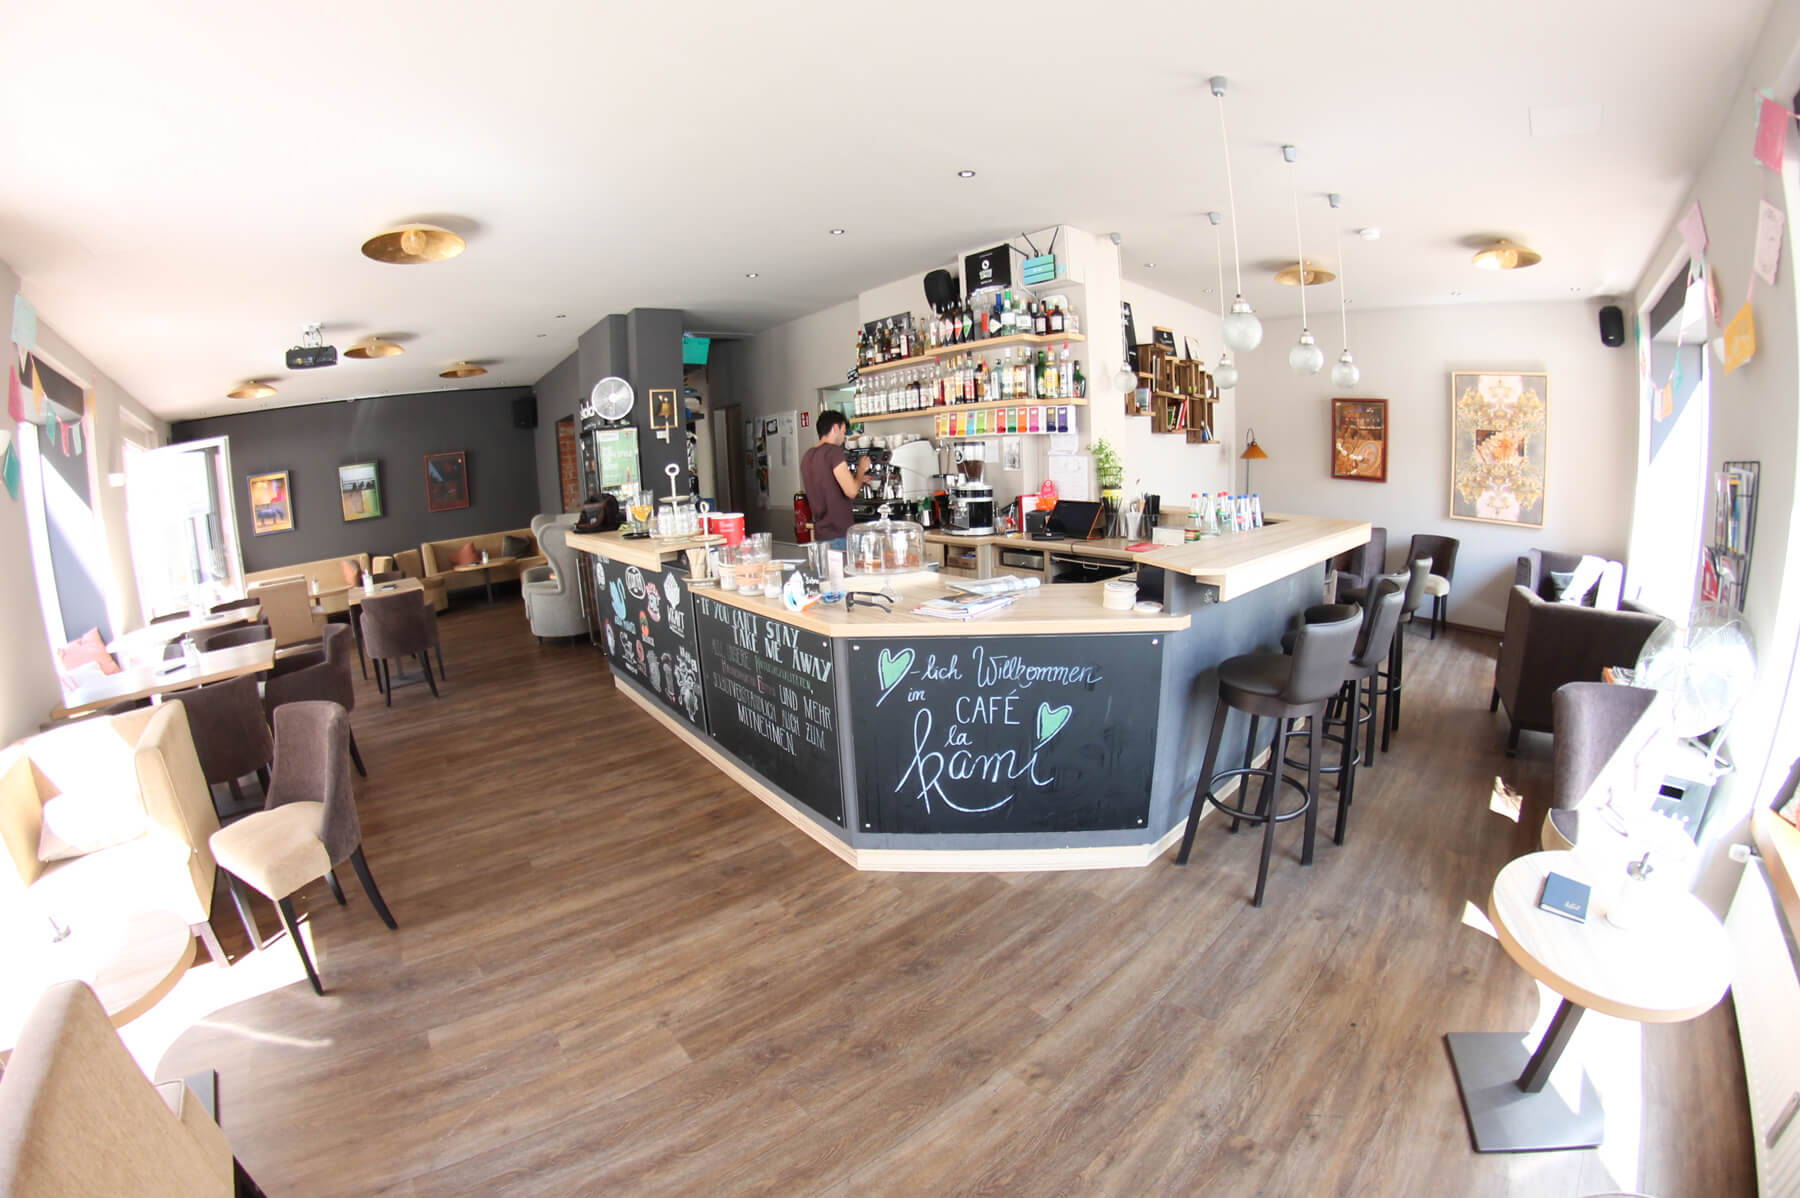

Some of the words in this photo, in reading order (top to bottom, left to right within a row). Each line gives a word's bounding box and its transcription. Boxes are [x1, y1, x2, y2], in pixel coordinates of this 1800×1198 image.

[701, 597, 710, 616] IF
[766, 621, 800, 648] STAY
[732, 624, 758, 654] TAKE
[764, 638, 783, 663] ME
[793, 648, 832, 683] AWAY
[972, 645, 1103, 689] Willkommen
[779, 684, 798, 711] UND
[803, 695, 833, 732] MEHR
[955, 689, 1022, 725] CAFÉ
[805, 722, 826, 751] ZUM
[944, 724, 973, 748] la
